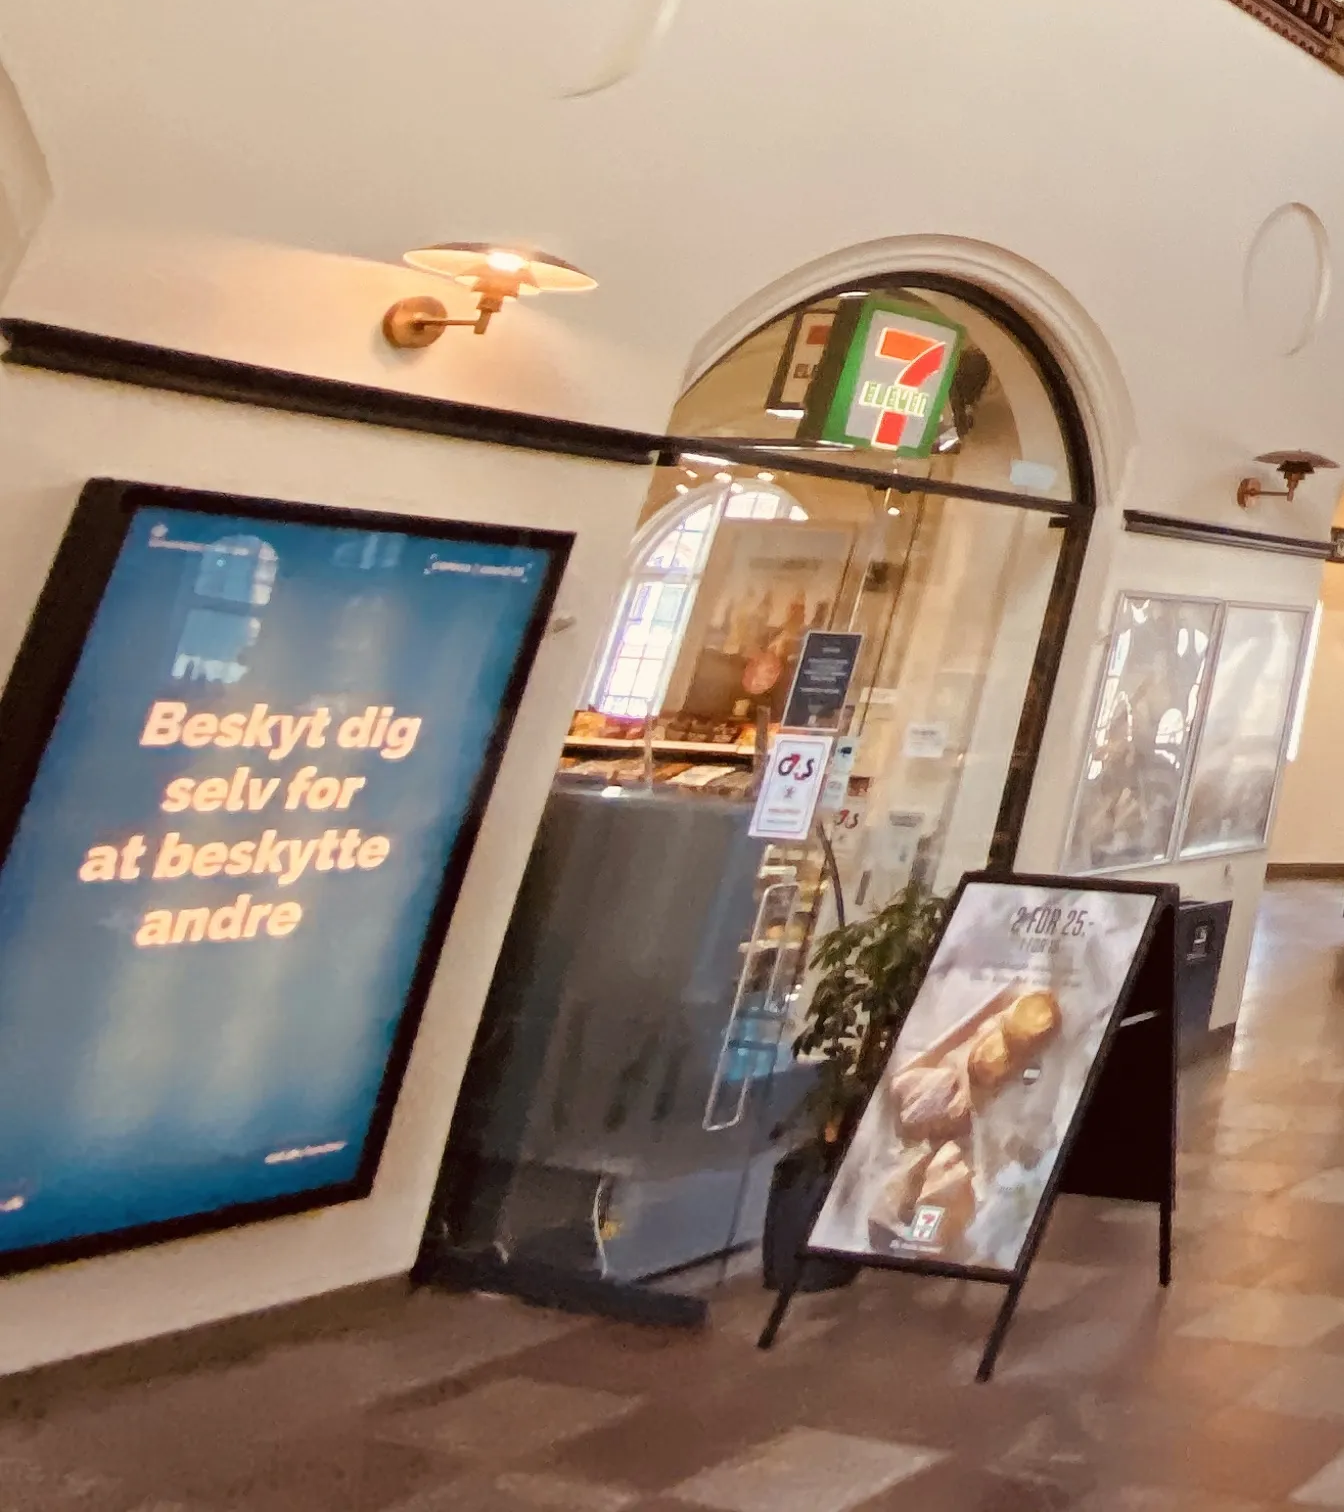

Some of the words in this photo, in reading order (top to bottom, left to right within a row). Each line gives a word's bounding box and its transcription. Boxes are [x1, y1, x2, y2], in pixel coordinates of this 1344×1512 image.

[871, 327, 947, 451] 7
[139, 700, 332, 761] Beskyt
[336, 705, 423, 760] dig
[160, 766, 282, 812] selv
[284, 765, 367, 811] for
[79, 834, 147, 882] at
[152, 828, 391, 887] beskytte
[135, 894, 303, 946] andre
[1011, 906, 1027, 933] 2
[1027, 905, 1062, 935] FOR
